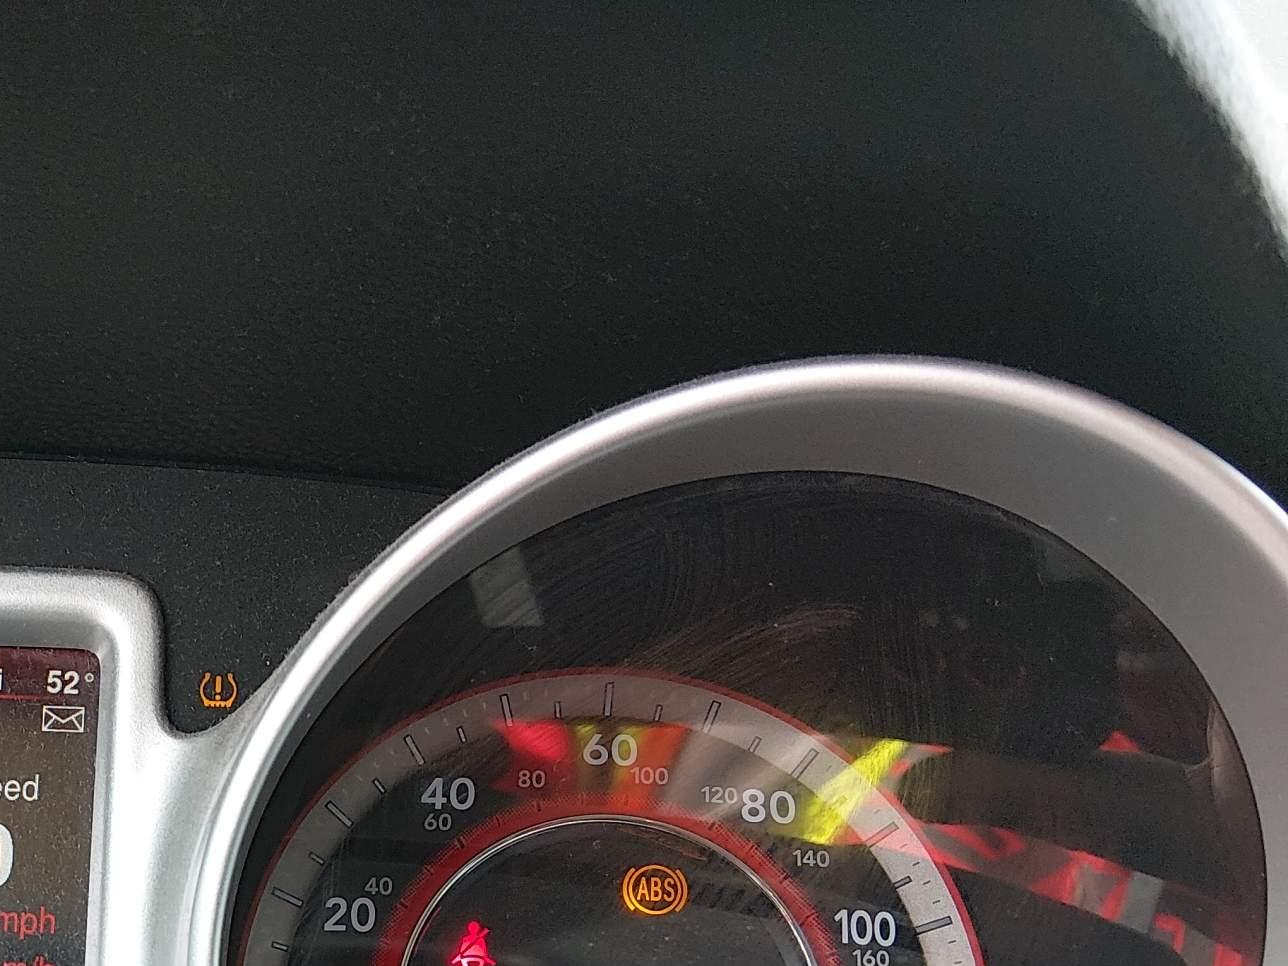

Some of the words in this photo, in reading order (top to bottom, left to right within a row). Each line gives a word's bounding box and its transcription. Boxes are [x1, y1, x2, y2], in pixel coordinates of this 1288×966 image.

[584, 734, 637, 766] 60
[518, 769, 546, 788] 80
[631, 767, 669, 785] 100
[421, 778, 476, 810] 40
[701, 787, 738, 804] 120
[742, 789, 796, 824] 80
[424, 813, 452, 831] 60
[793, 849, 830, 869] 140
[365, 878, 393, 896] 40
[637, 875, 676, 904] ABS
[323, 898, 377, 932] 20
[835, 910, 896, 947] 100
